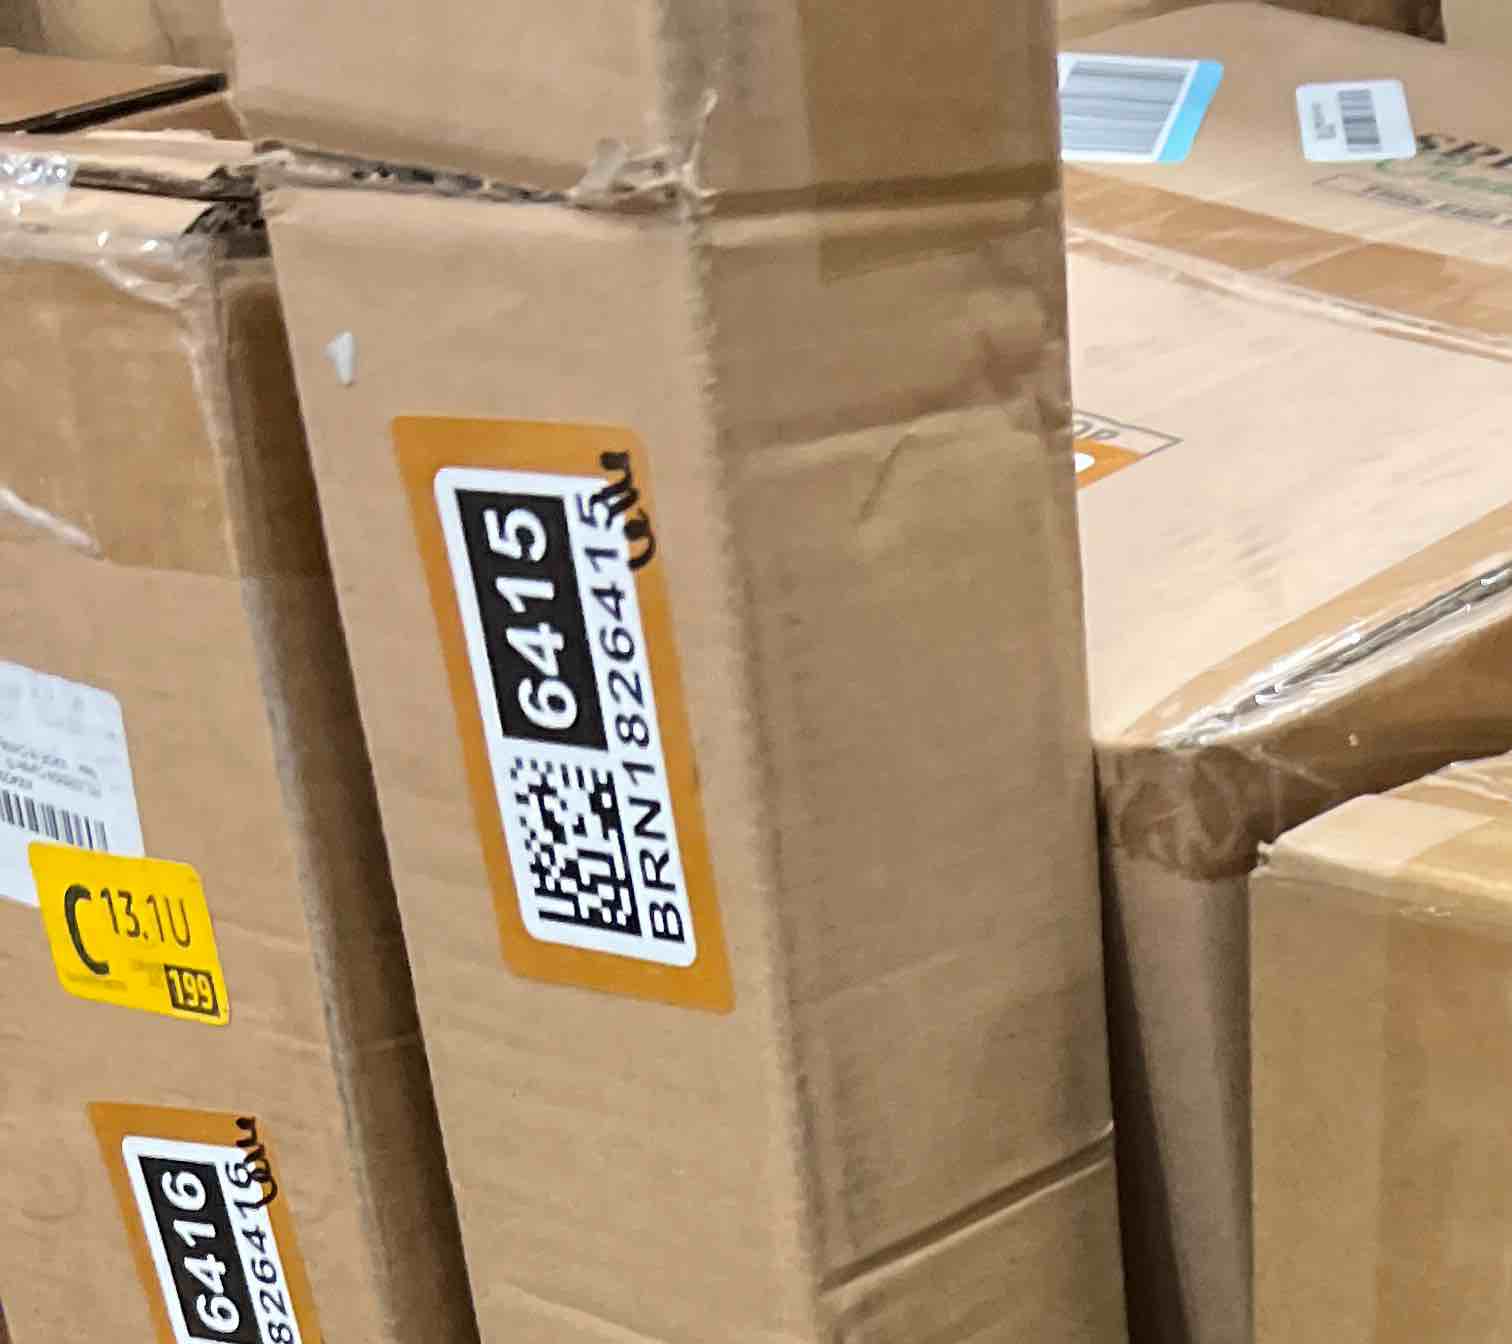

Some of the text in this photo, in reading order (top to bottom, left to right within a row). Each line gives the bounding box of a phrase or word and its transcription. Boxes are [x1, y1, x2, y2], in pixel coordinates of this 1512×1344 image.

[485, 506, 578, 731] 6415
[576, 490, 685, 943] BRN1826415
[64, 883, 110, 976] C
[168, 968, 216, 1011] 199
[161, 1166, 240, 1335] 6416
